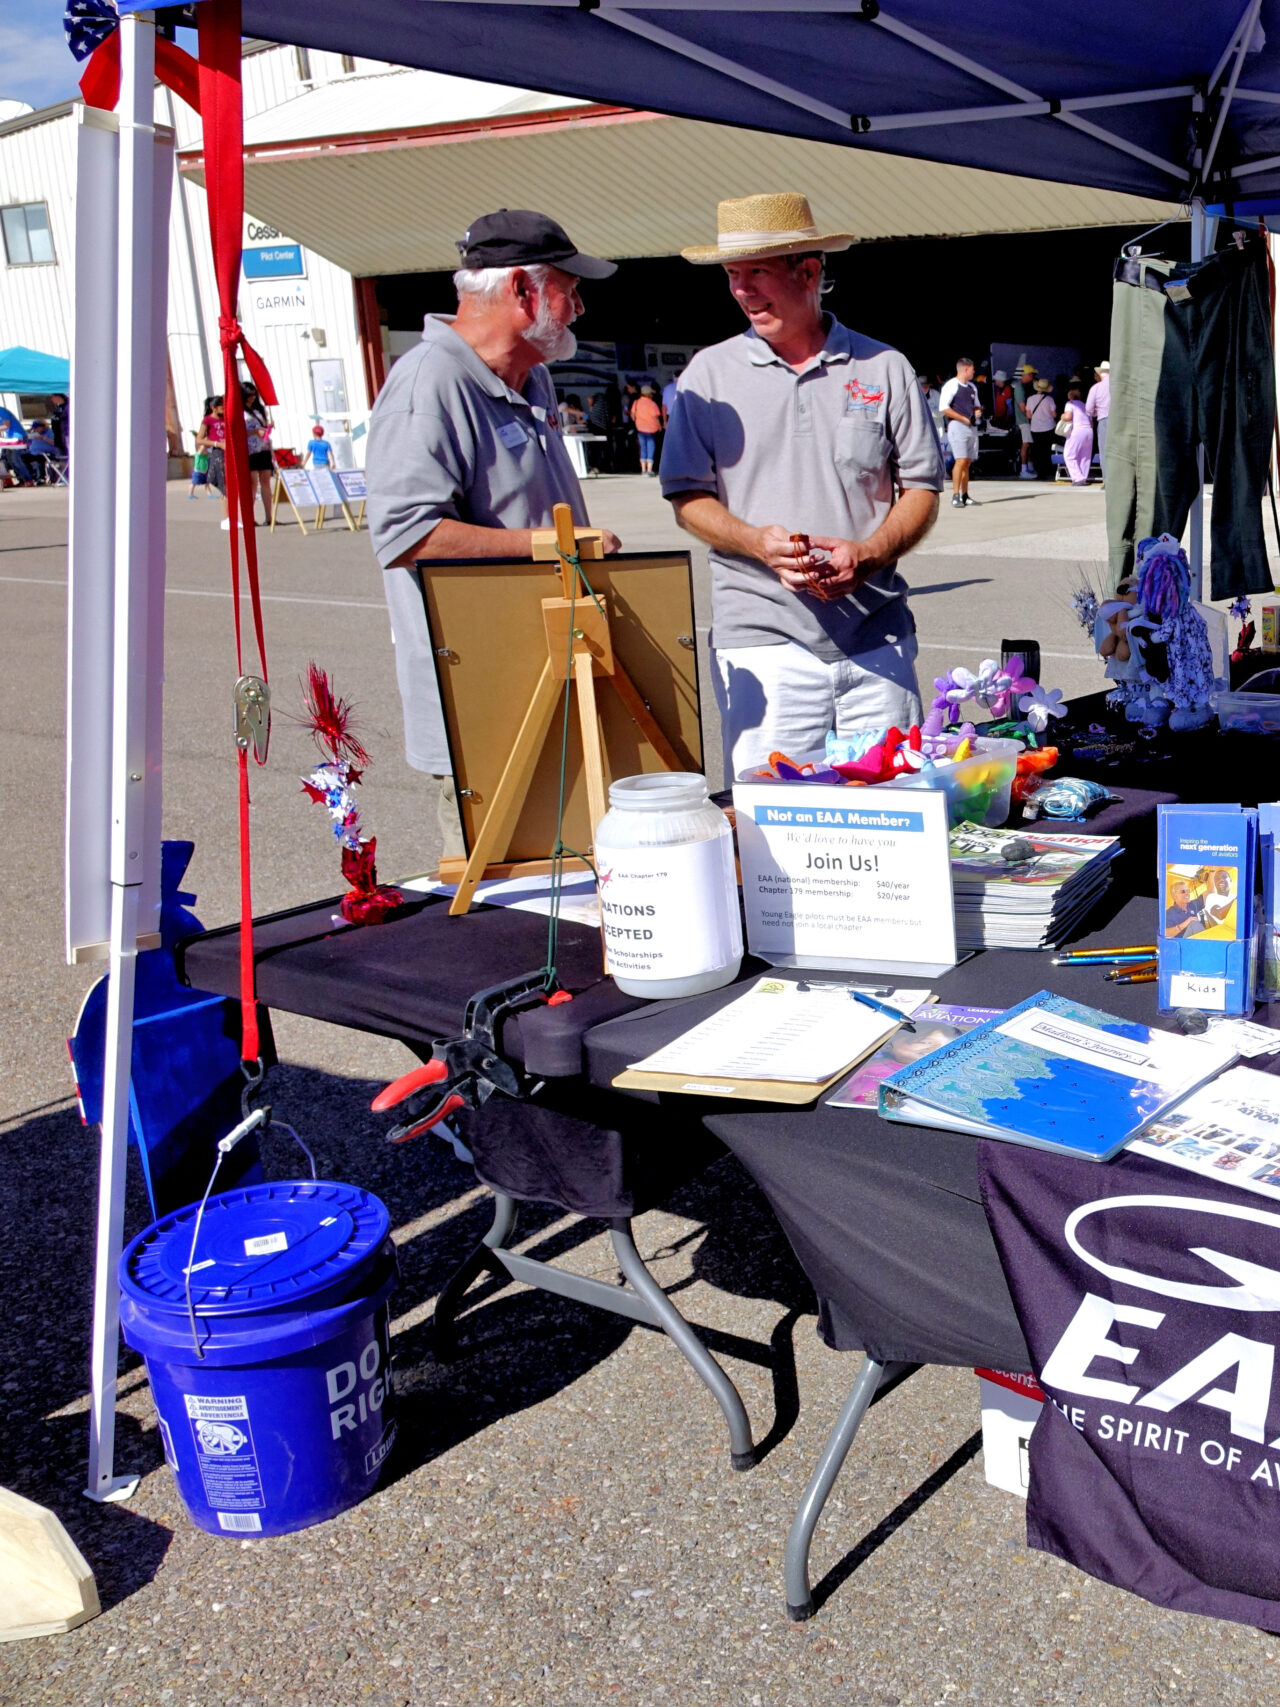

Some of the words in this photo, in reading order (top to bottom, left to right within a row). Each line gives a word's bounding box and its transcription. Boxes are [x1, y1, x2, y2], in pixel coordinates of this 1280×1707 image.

[260, 252, 273, 260] Pilot
[274, 251, 294, 260] Center
[256, 295, 306, 310] GARMIN
[1131, 683, 1151, 693] 179
[767, 809, 792, 822] Not
[795, 812, 813, 823] an
[816, 812, 845, 824] EAA
[848, 812, 910, 827] Member?
[787, 832, 811, 843] We'd
[814, 834, 831, 844] love
[838, 836, 848, 845] to
[851, 835, 874, 846] have
[878, 838, 896, 848] you
[1198, 844, 1238, 852] generation
[806, 852, 842, 870] Join
[849, 855, 879, 872] Us!
[774, 876, 810, 885] (national)
[812, 878, 860, 887] membership:
[876, 881, 910, 890] $40/year
[759, 886, 787, 895] Chapter
[790, 887, 803, 895] 179
[805, 888, 853, 898] membership:
[877, 892, 910, 901] $20/year
[761, 910, 783, 920] Young
[785, 912, 803, 920] Eagle
[805, 913, 824, 922] pilots
[857, 915, 872, 923] EAA
[874, 916, 908, 925] members
[909, 918, 922, 926] but
[782, 920, 793, 928] not
[795, 921, 809, 929] join
[835, 923, 862, 932] chapter
[614, 948, 663, 959] Scholarships
[616, 960, 651, 970] Activities
[1188, 982, 1217, 993] Kids
[914, 1011, 991, 1025] AVIATION
[1038, 1024, 1090, 1048] Madison's
[326, 1340, 380, 1405] DO
[1046, 1395, 1085, 1433] HE
[1098, 1414, 1190, 1456] SPIRIT
[1201, 1440, 1242, 1472] OF
